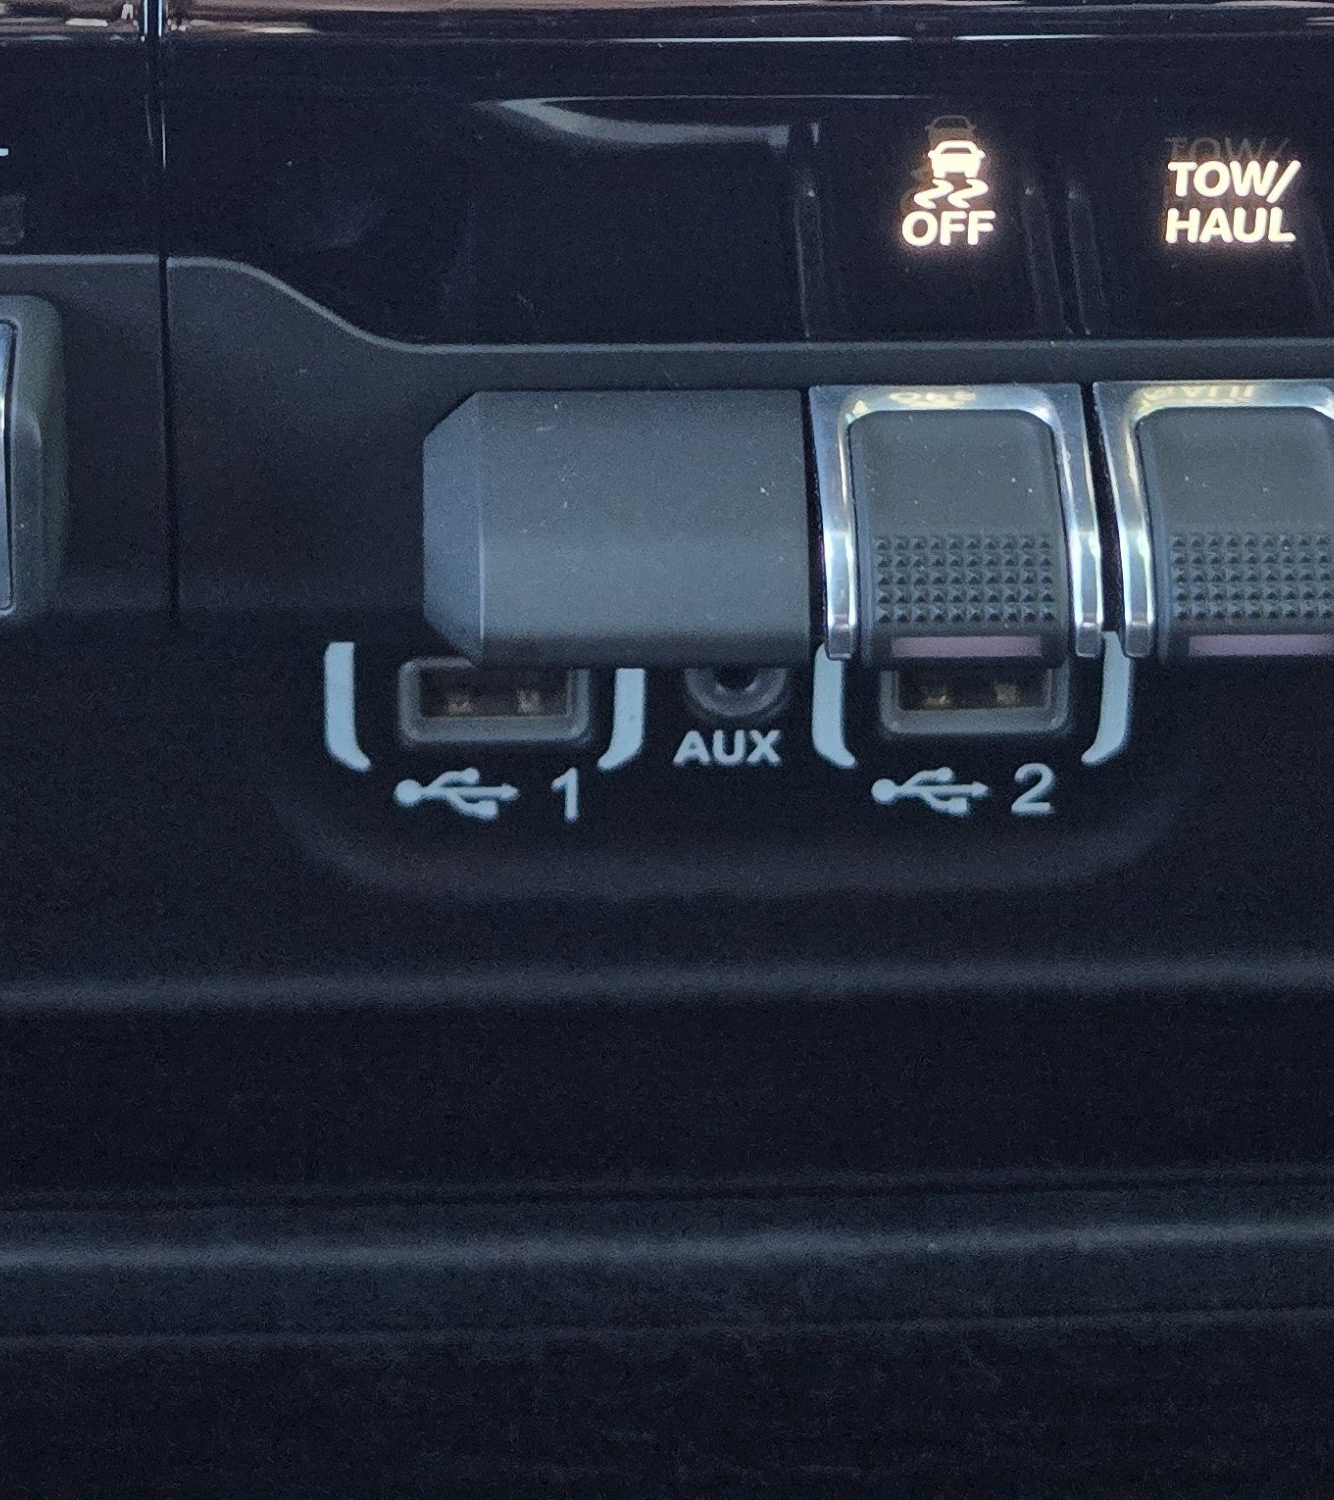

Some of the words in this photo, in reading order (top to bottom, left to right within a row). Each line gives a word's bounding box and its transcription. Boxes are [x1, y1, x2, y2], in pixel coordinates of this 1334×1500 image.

[1166, 159, 1302, 203] TOW/
[901, 208, 997, 247] OFF
[1165, 206, 1296, 243] HAUL
[672, 729, 782, 766] AUX
[551, 767, 580, 822] 1
[1010, 763, 1056, 815] 2
